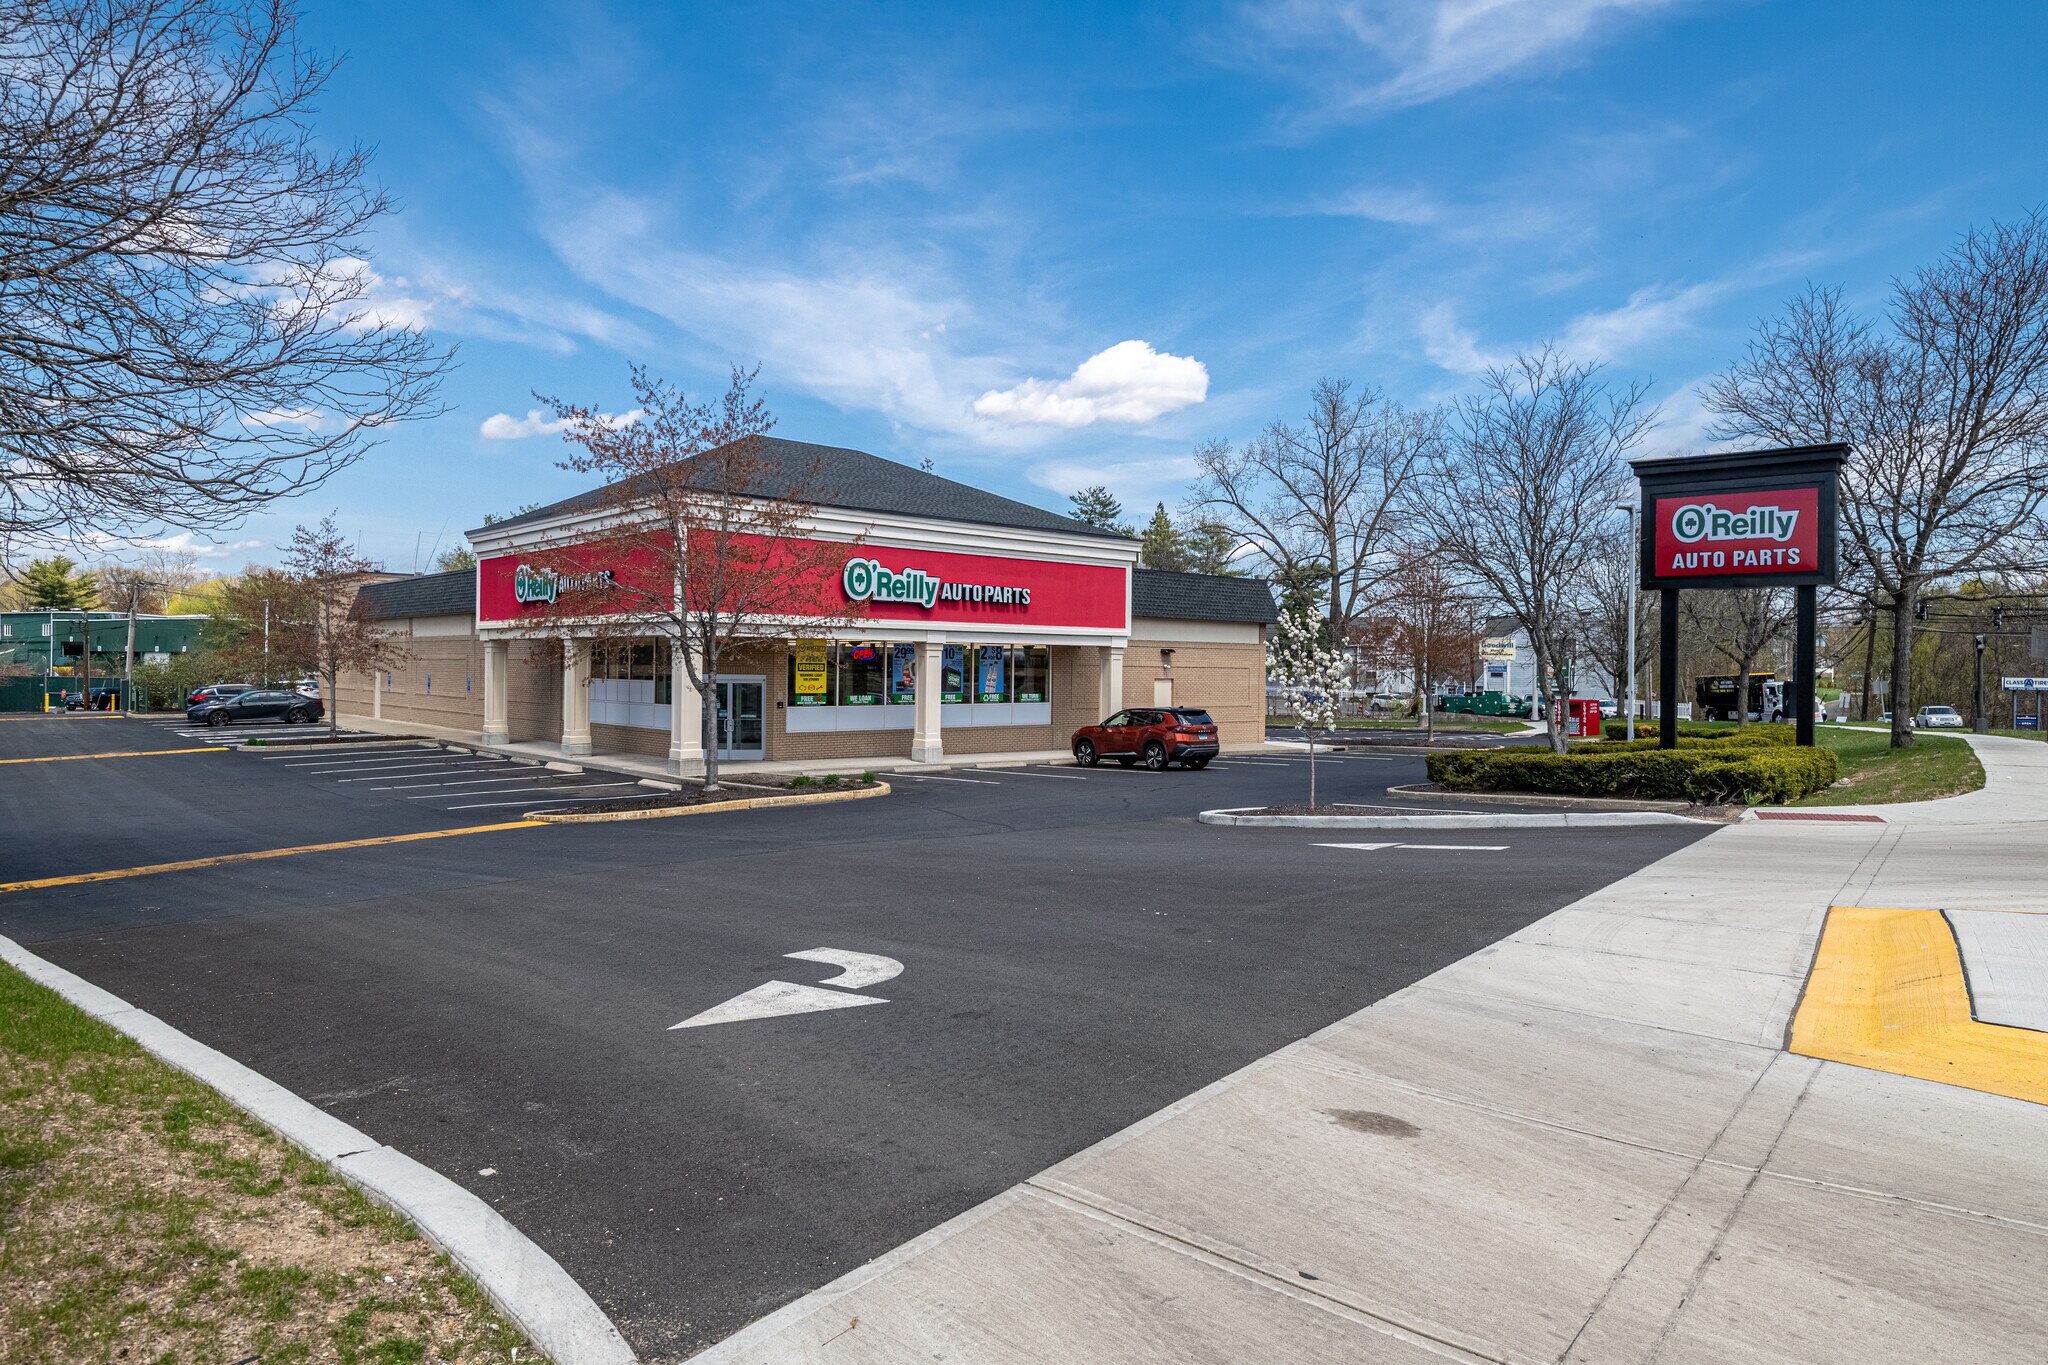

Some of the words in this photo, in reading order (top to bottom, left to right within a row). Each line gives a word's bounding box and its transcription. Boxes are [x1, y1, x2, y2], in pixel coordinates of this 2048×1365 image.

[1673, 504, 1798, 542] O'Reilly
[1672, 551, 1725, 570] AUTO
[1733, 547, 1800, 567] PARTS
[844, 559, 939, 608] O'Reilly
[941, 582, 982, 602] AUTO
[984, 586, 1031, 605] PARTS
[853, 648, 873, 660] OPEN
[980, 646, 988, 660] 2
